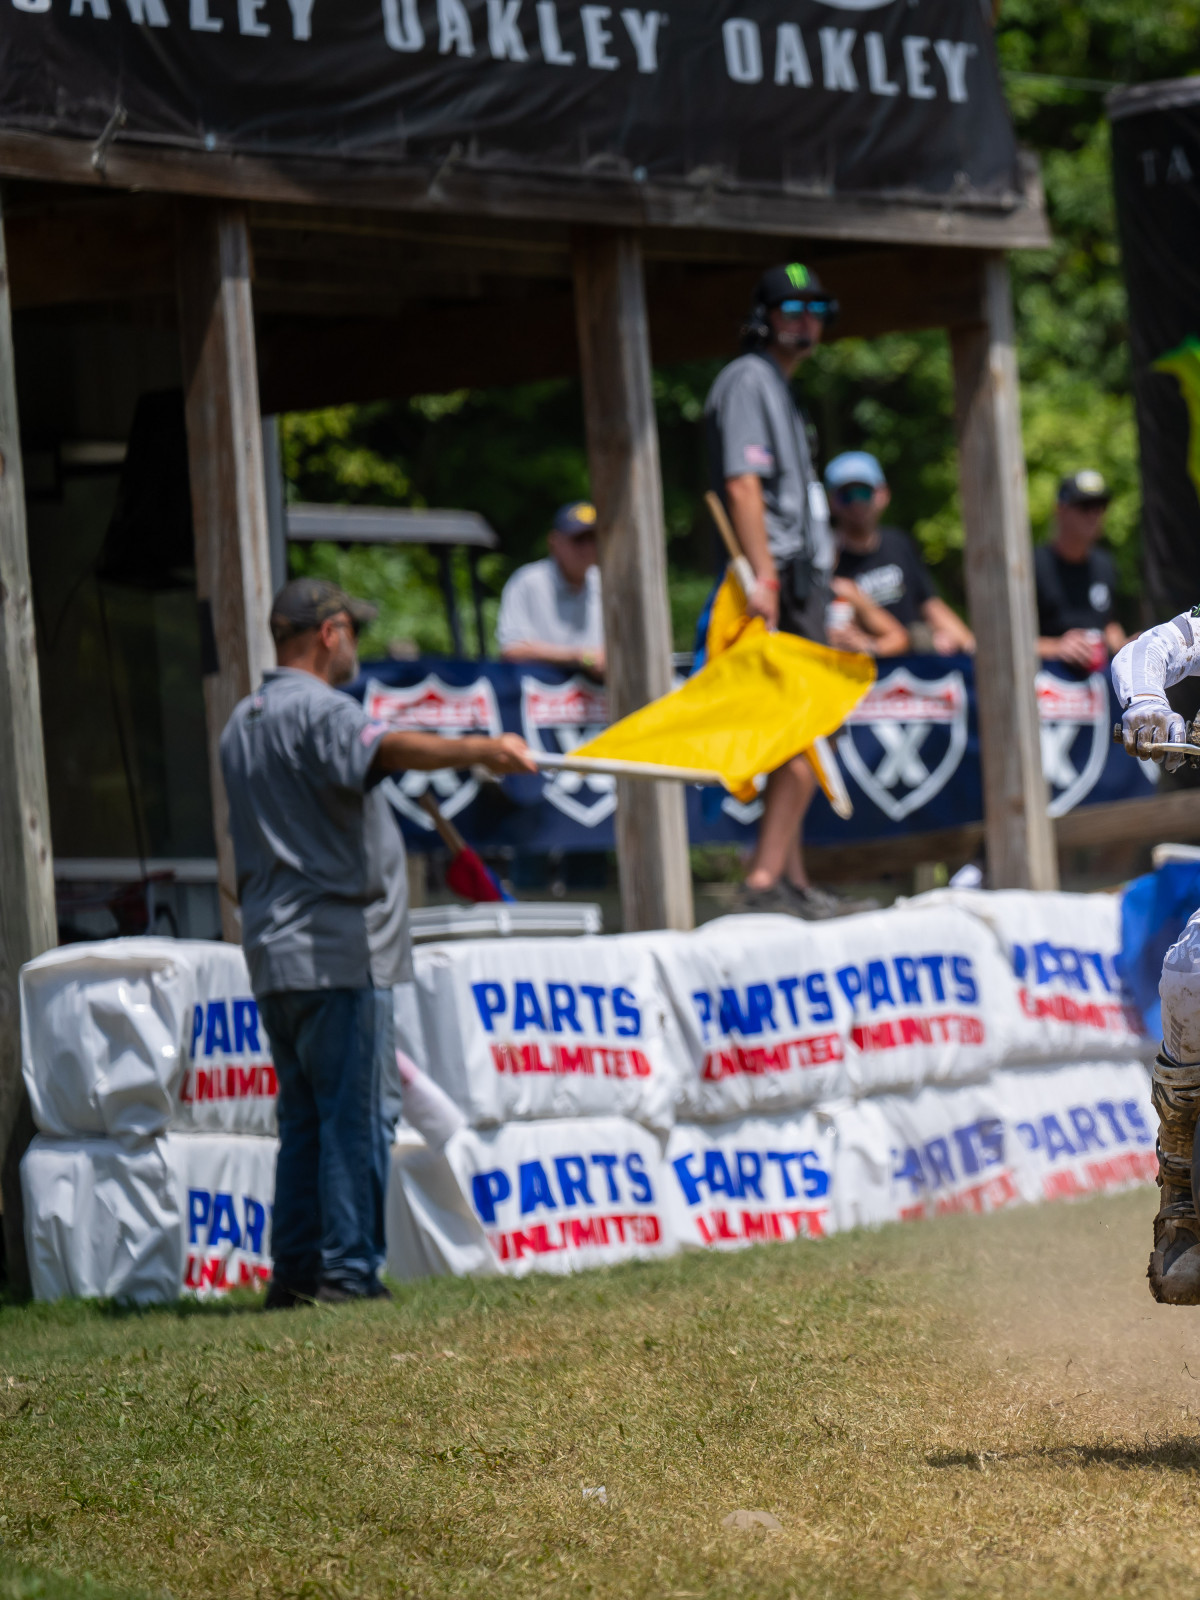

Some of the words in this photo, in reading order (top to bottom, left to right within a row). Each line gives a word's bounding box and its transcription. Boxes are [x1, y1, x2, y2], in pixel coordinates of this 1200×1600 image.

[12, 0, 315, 41] LEY
[384, 0, 660, 74] OAKLEY
[722, 18, 969, 103] OAKLEY
[472, 980, 642, 1038] PARTS
[692, 971, 834, 1042] PARTS
[836, 956, 979, 1014] PARTS
[472, 1153, 654, 1223] PARTS
